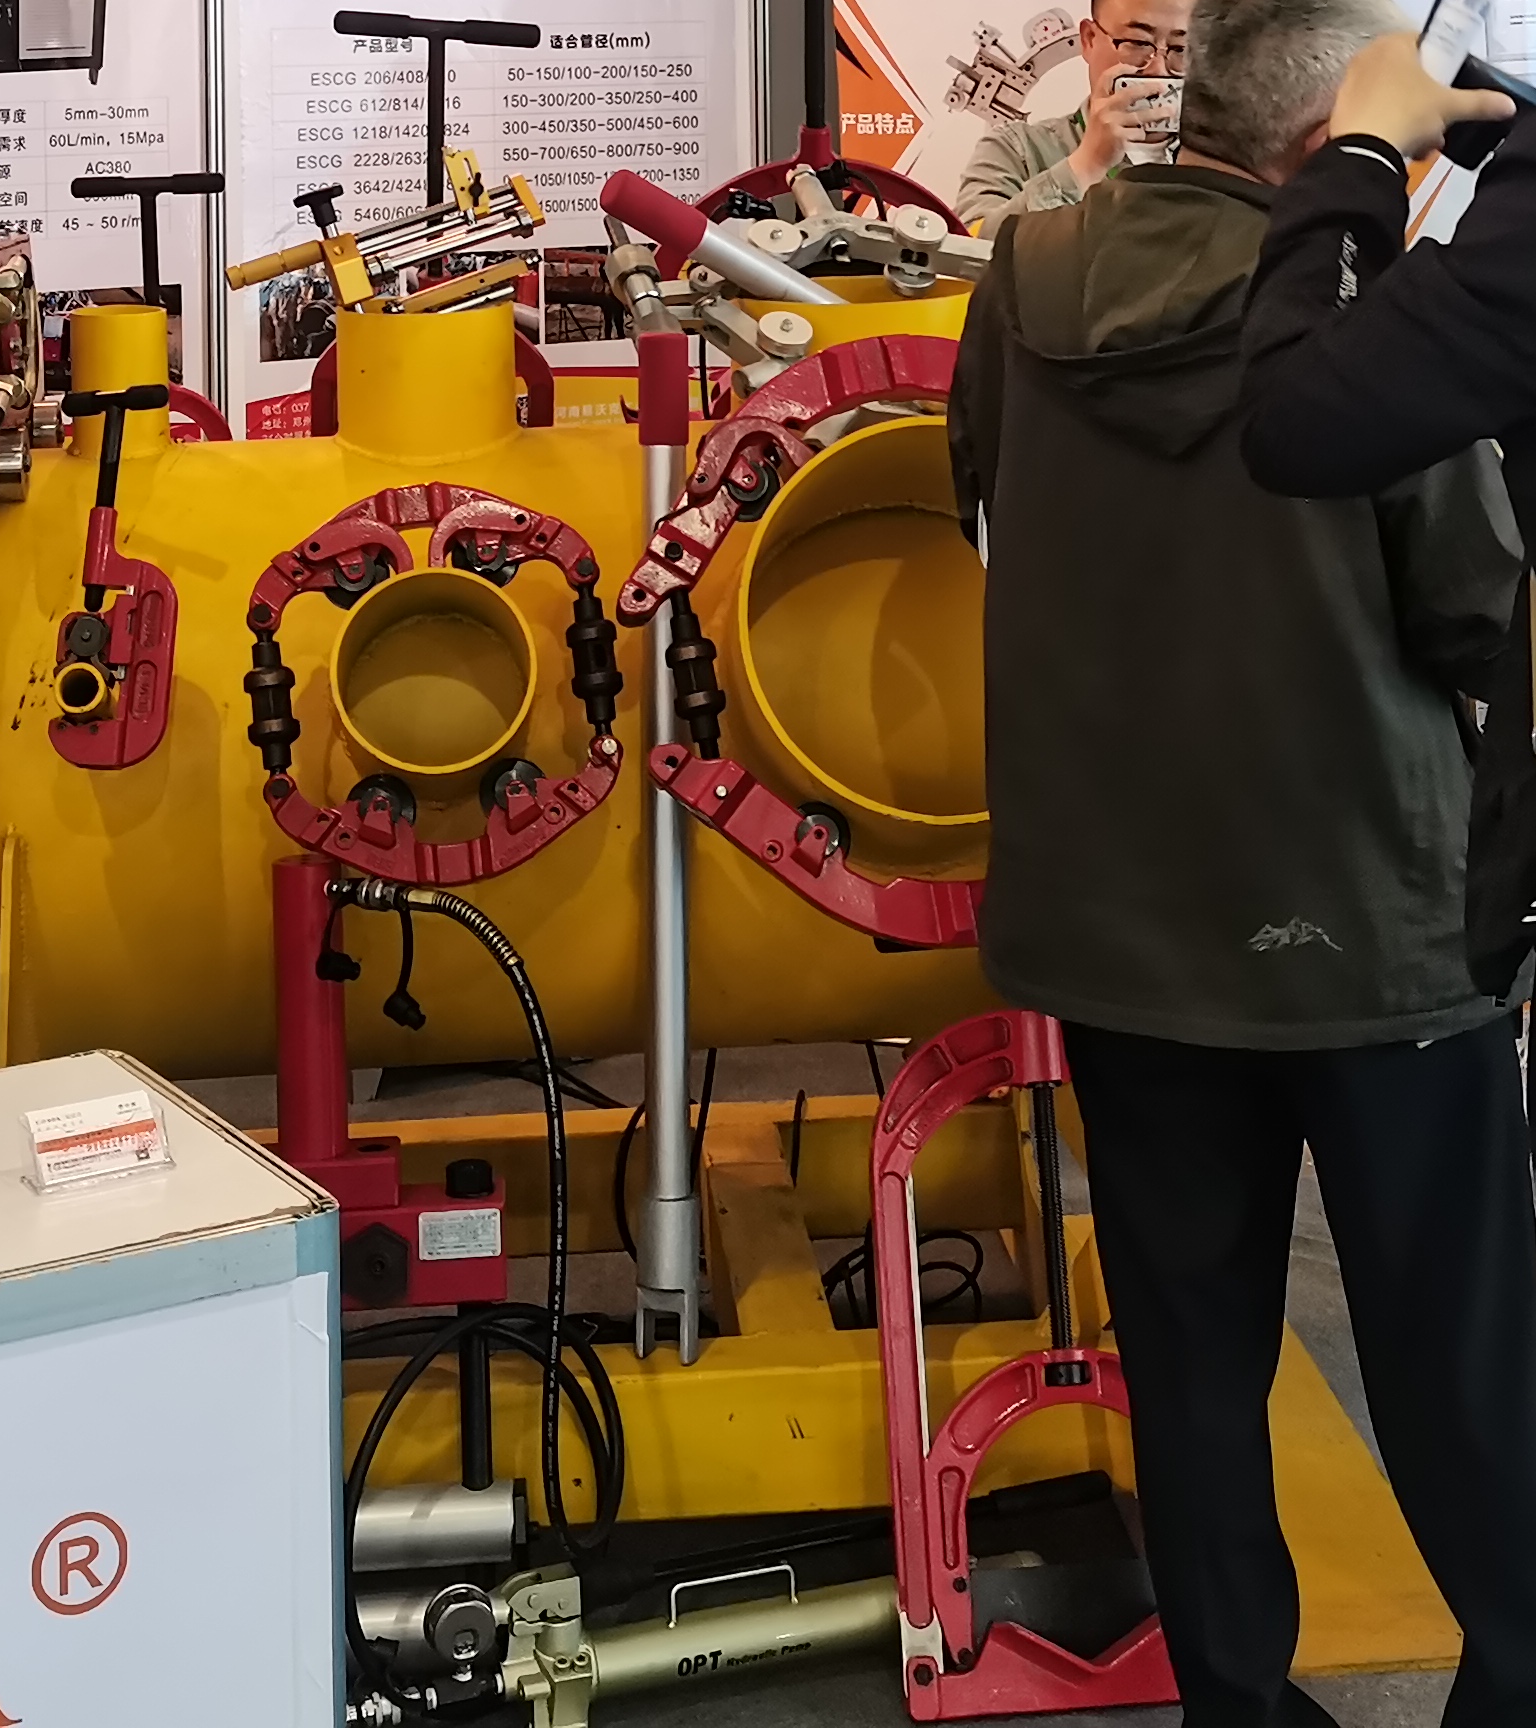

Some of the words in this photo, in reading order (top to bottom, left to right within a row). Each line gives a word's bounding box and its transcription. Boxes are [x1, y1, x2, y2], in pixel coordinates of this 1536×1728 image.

[352, 38, 413, 54] 产品型号
[549, 32, 651, 50] 适合管径(mm)
[310, 70, 358, 86] ESCG
[507, 63, 693, 82] 50-150/100-200/150-250
[64, 105, 149, 120] 5mm-30mm
[306, 98, 353, 114] ESCG
[502, 89, 698, 109] 150-300/200-350/250-400
[297, 126, 344, 143] ESCG
[502, 116, 699, 135] 300-450/350-500/450-600
[841, 110, 916, 137] 产品特点
[296, 154, 343, 170] ESCG
[502, 141, 700, 162] 550-700/650-800/750-900
[85, 161, 132, 176] AC380
[677, 1649, 723, 1677] OPT
